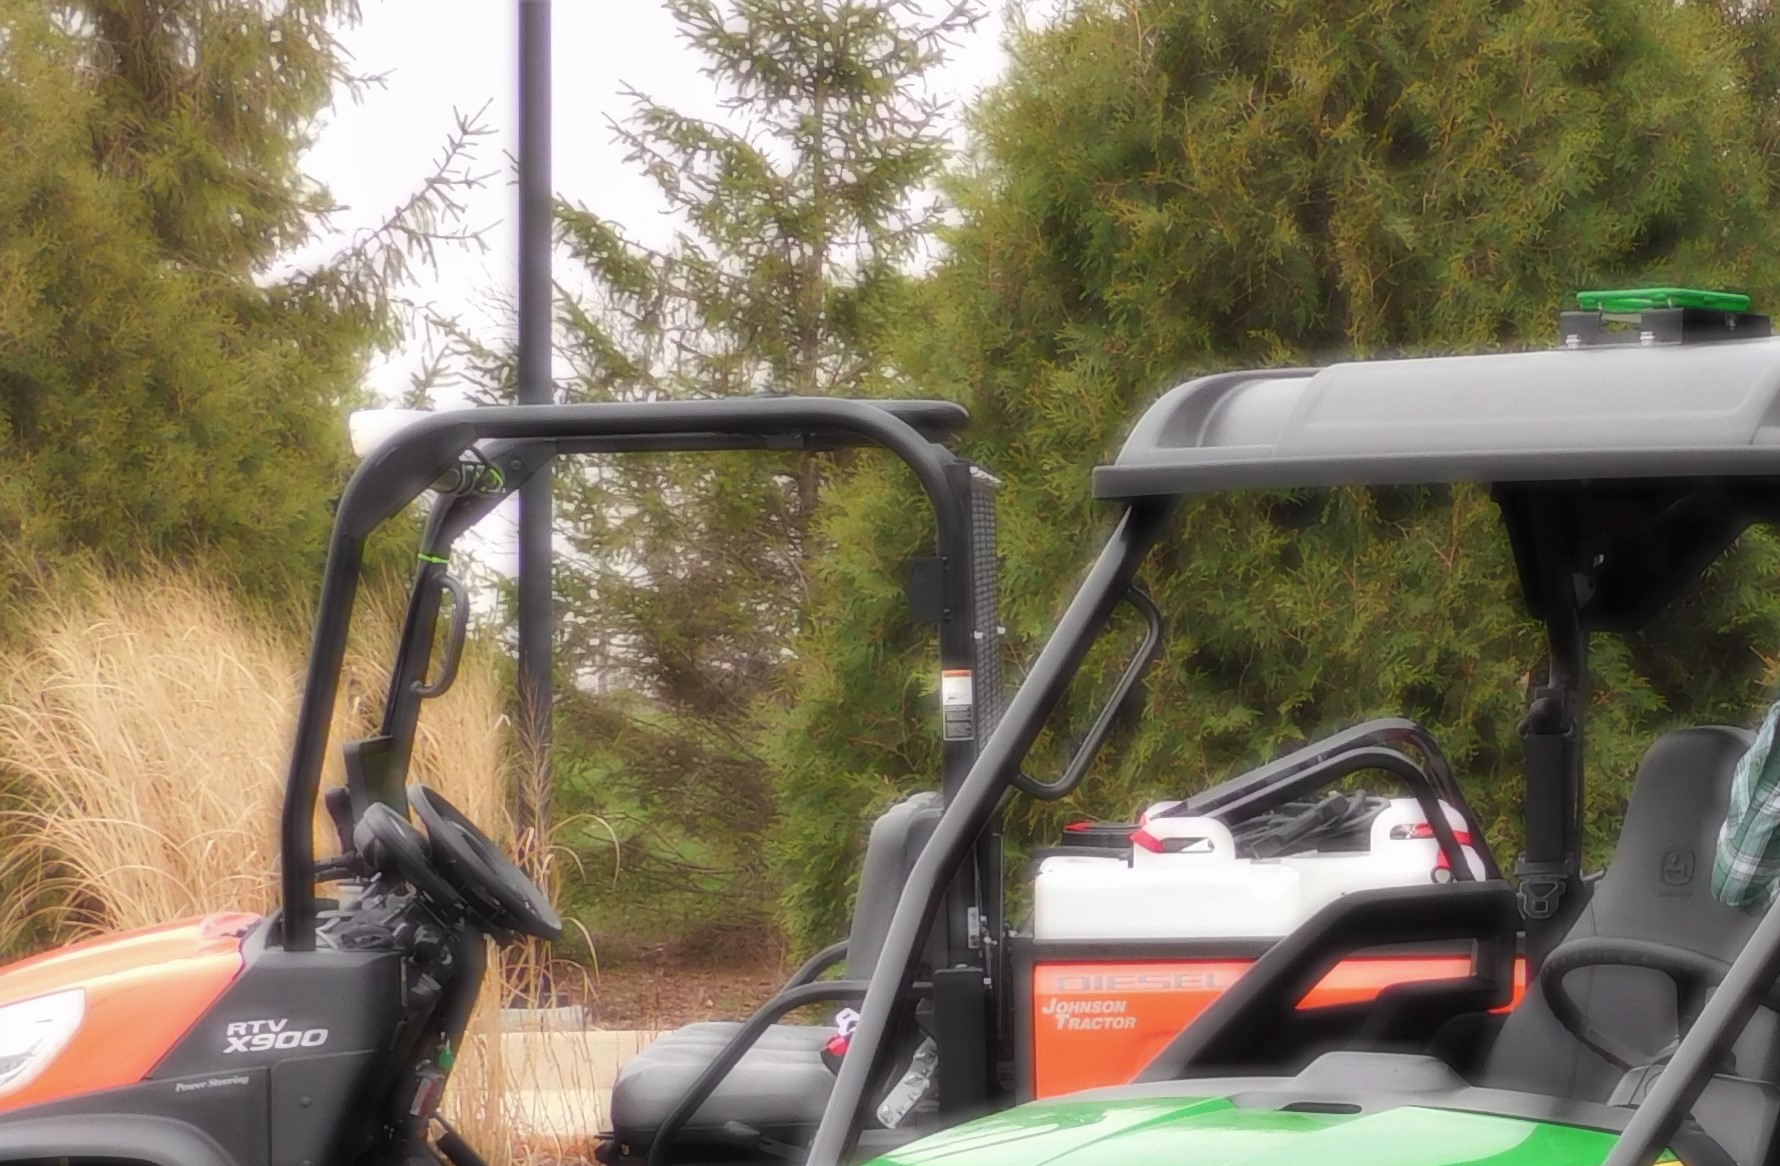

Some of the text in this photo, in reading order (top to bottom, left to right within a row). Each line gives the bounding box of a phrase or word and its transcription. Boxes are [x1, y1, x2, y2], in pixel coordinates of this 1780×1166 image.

[1056, 973, 1228, 992] DIESEL
[1042, 998, 1127, 1015] JOHNSON
[226, 1018, 288, 1036] RTV
[1055, 1013, 1136, 1029] TRACTOR
[222, 1028, 329, 1054] X900
